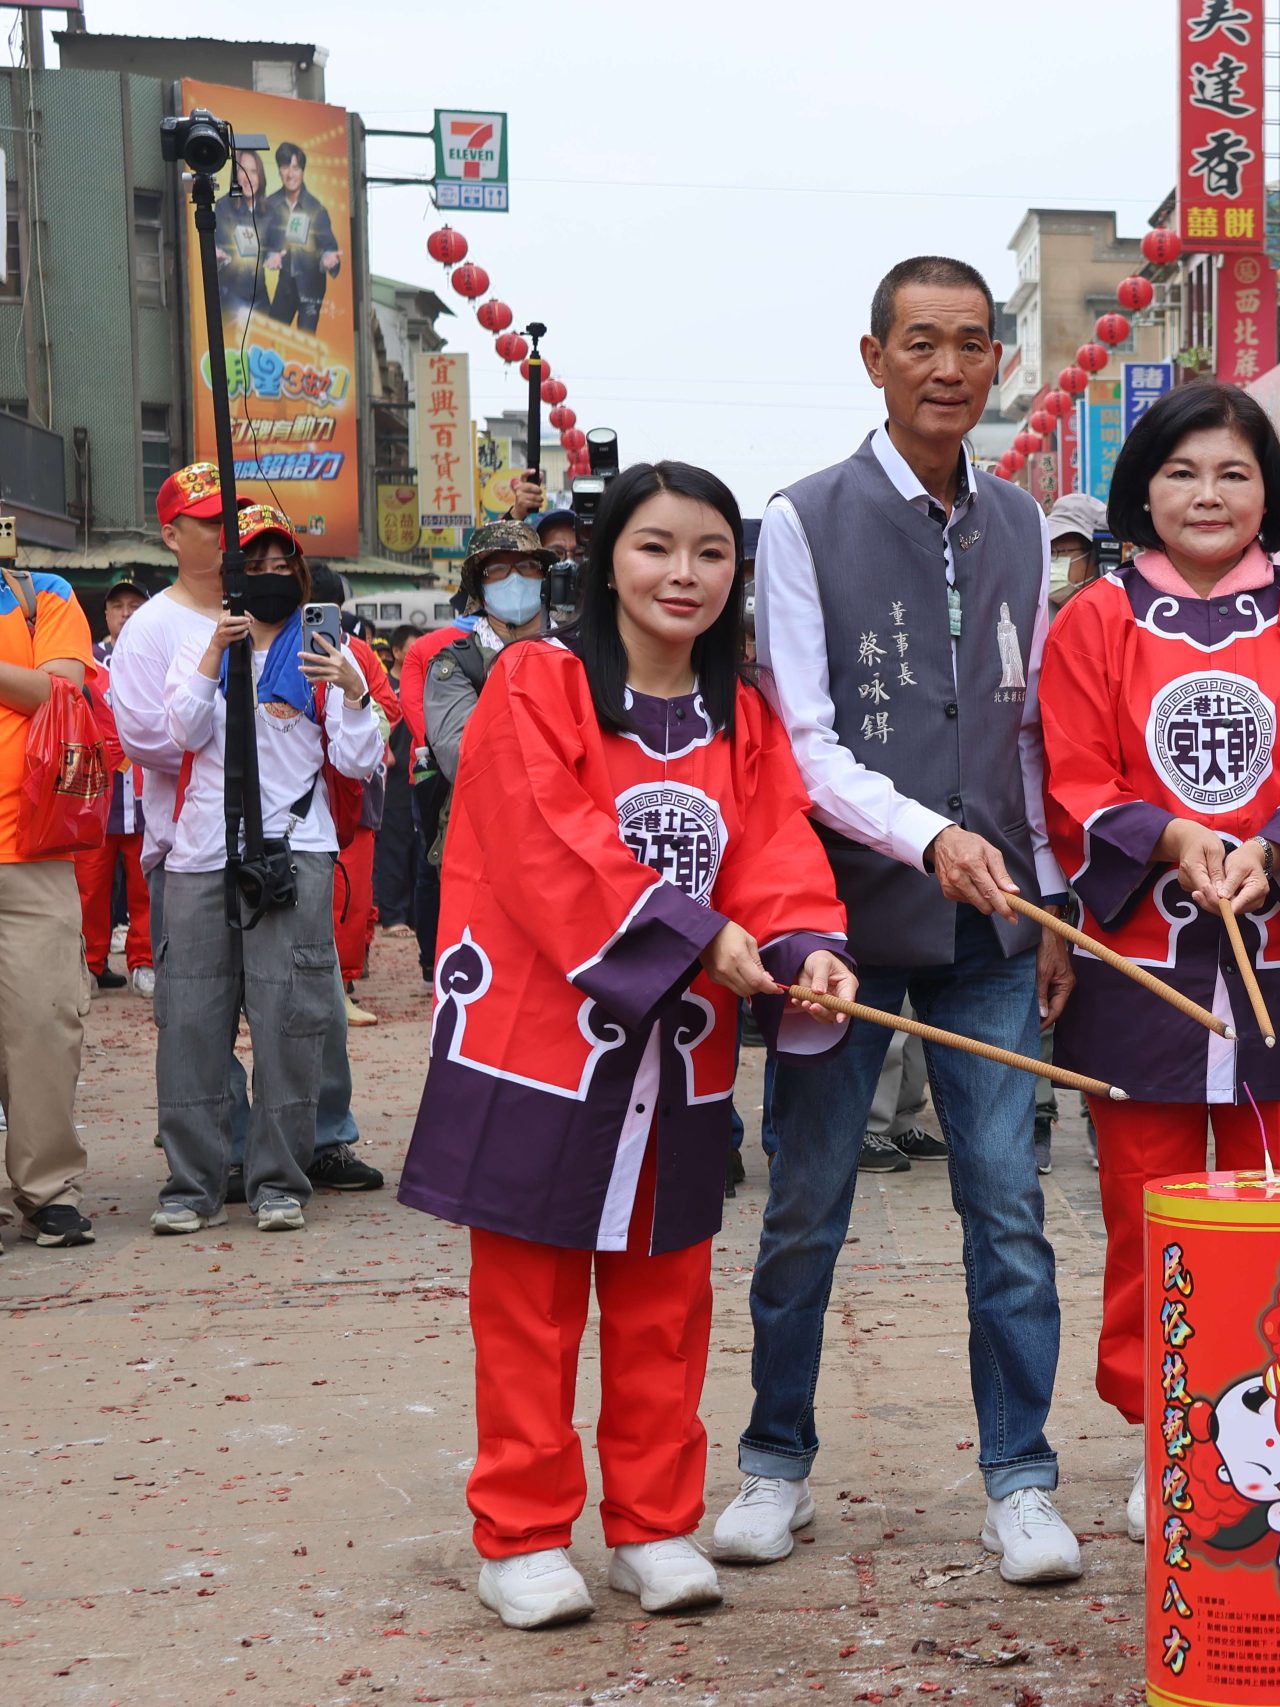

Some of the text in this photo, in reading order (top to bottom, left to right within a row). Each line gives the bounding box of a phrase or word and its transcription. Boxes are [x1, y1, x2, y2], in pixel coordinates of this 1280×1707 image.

[1187, 207, 1255, 238] 囍餅
[427, 356, 462, 513] 宜興百貨行
[889, 601, 918, 686] 董事長
